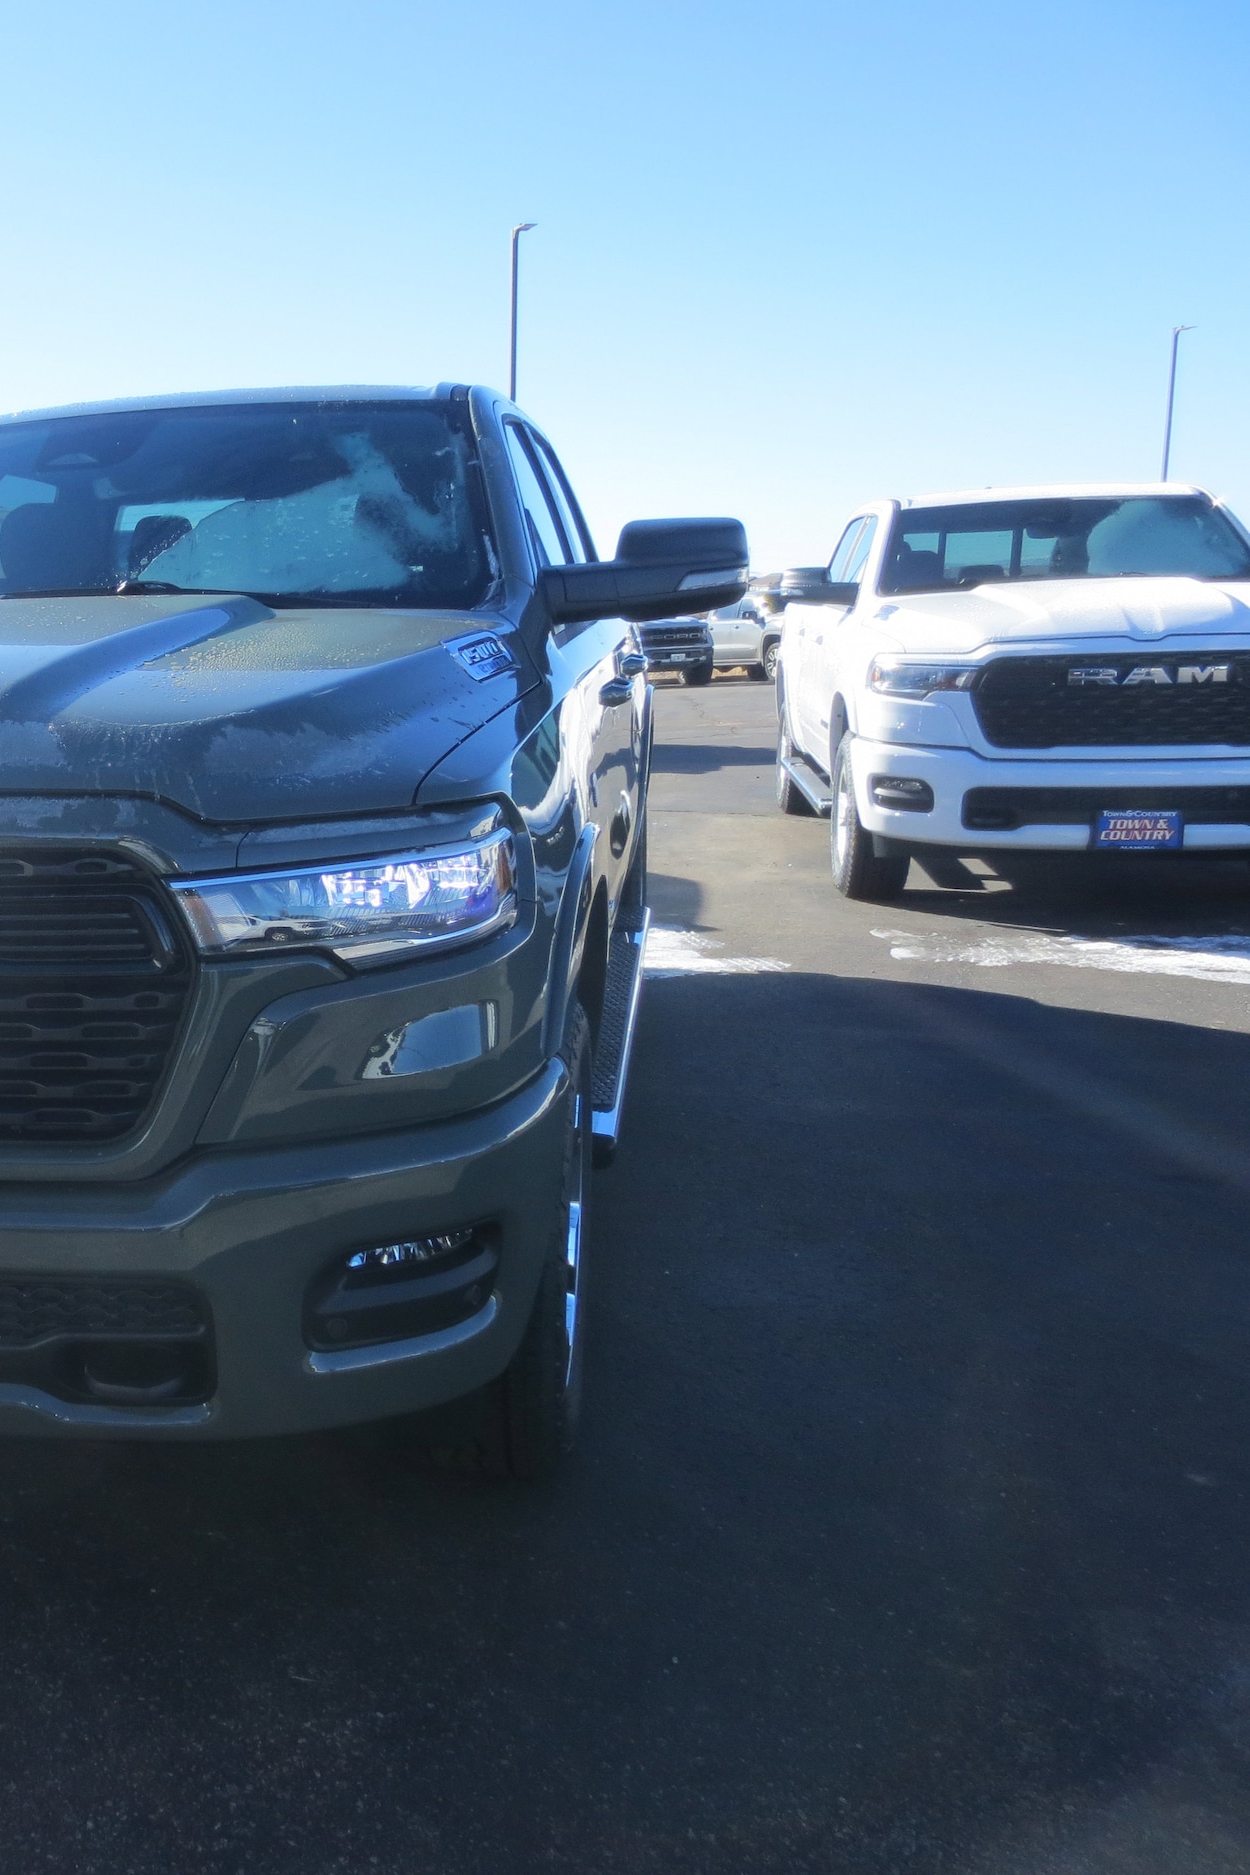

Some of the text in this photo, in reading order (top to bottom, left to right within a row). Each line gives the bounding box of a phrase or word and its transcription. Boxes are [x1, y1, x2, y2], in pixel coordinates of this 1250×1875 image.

[1067, 666, 1230, 686] RAM
[1108, 818, 1169, 830] TOWN &
[1100, 830, 1175, 841] COUNTRY
